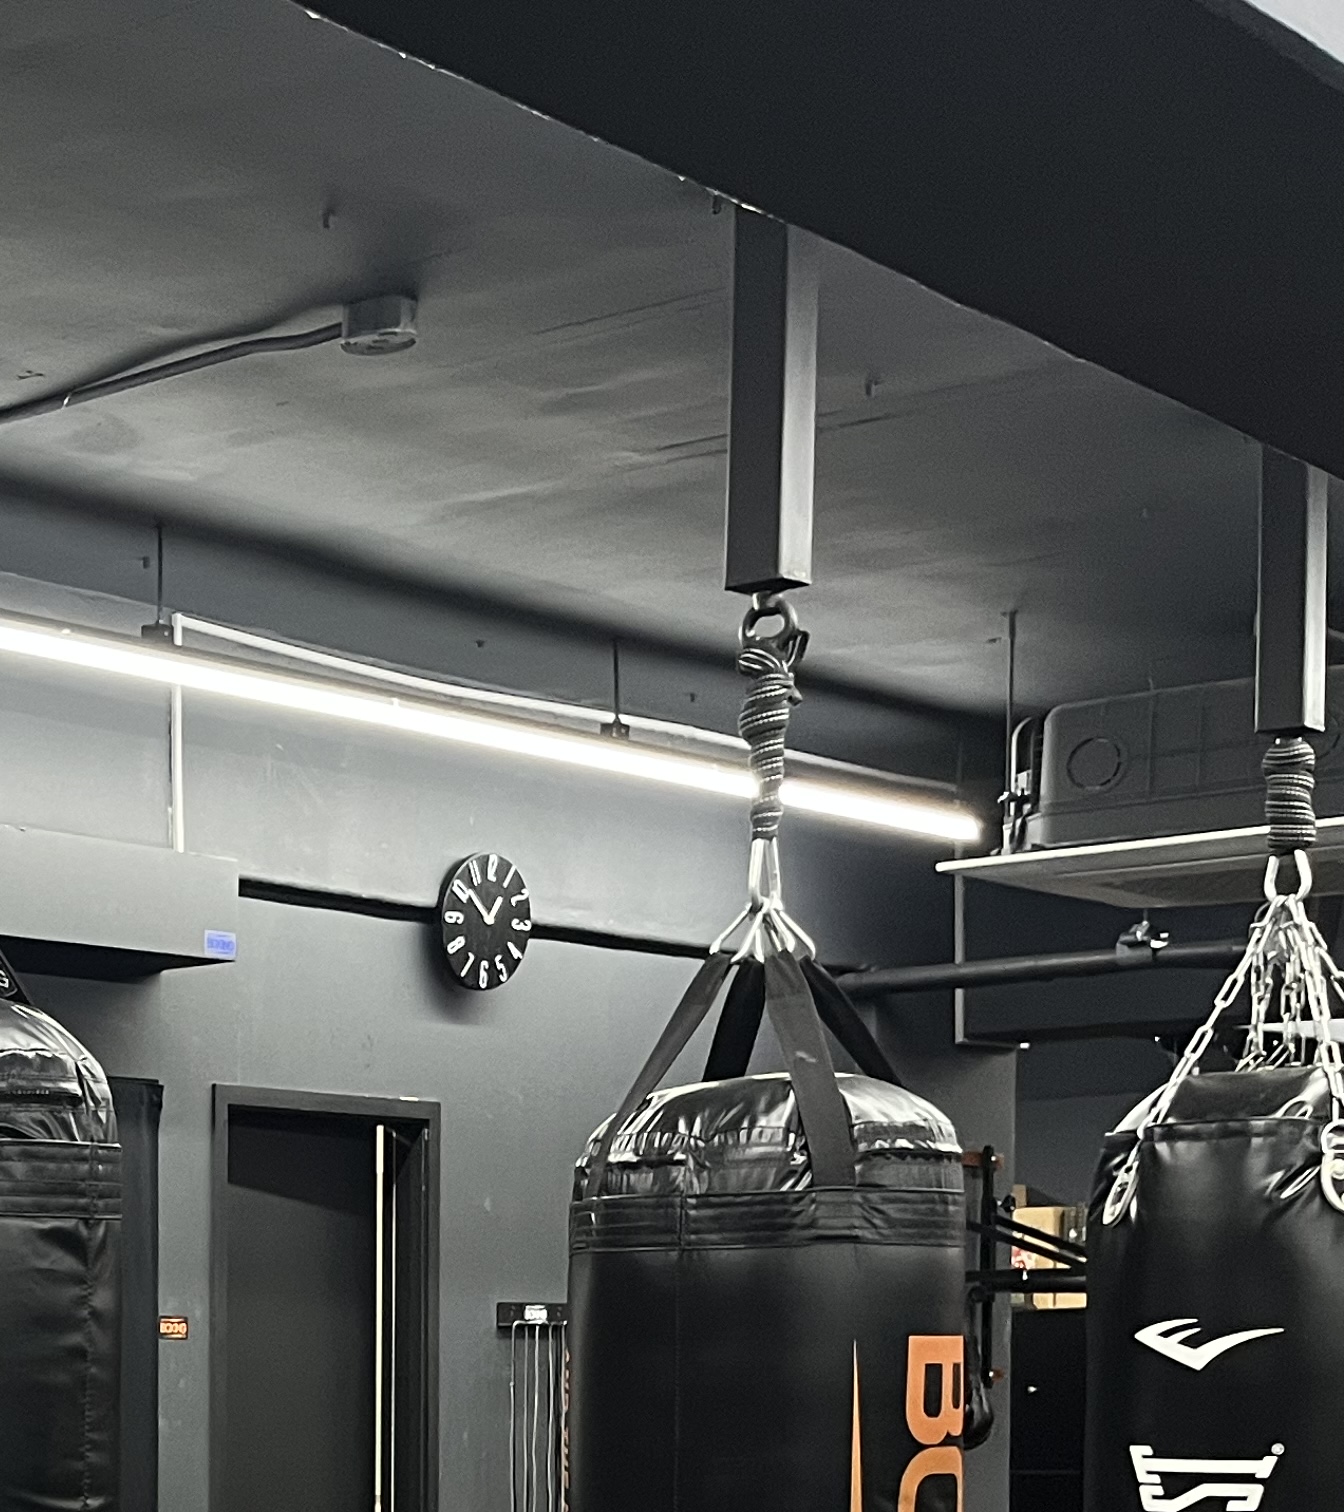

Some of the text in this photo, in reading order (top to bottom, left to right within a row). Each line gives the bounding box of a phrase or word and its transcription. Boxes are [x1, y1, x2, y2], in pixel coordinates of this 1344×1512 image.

[502, 864, 517, 888] 1
[510, 888, 530, 907] 2
[444, 910, 464, 925] 9
[511, 918, 532, 931] 3
[447, 935, 466, 954] 8
[506, 941, 523, 960] 4
[460, 952, 474, 977] 7
[494, 954, 508, 983] 5
[479, 960, 489, 989] 6
